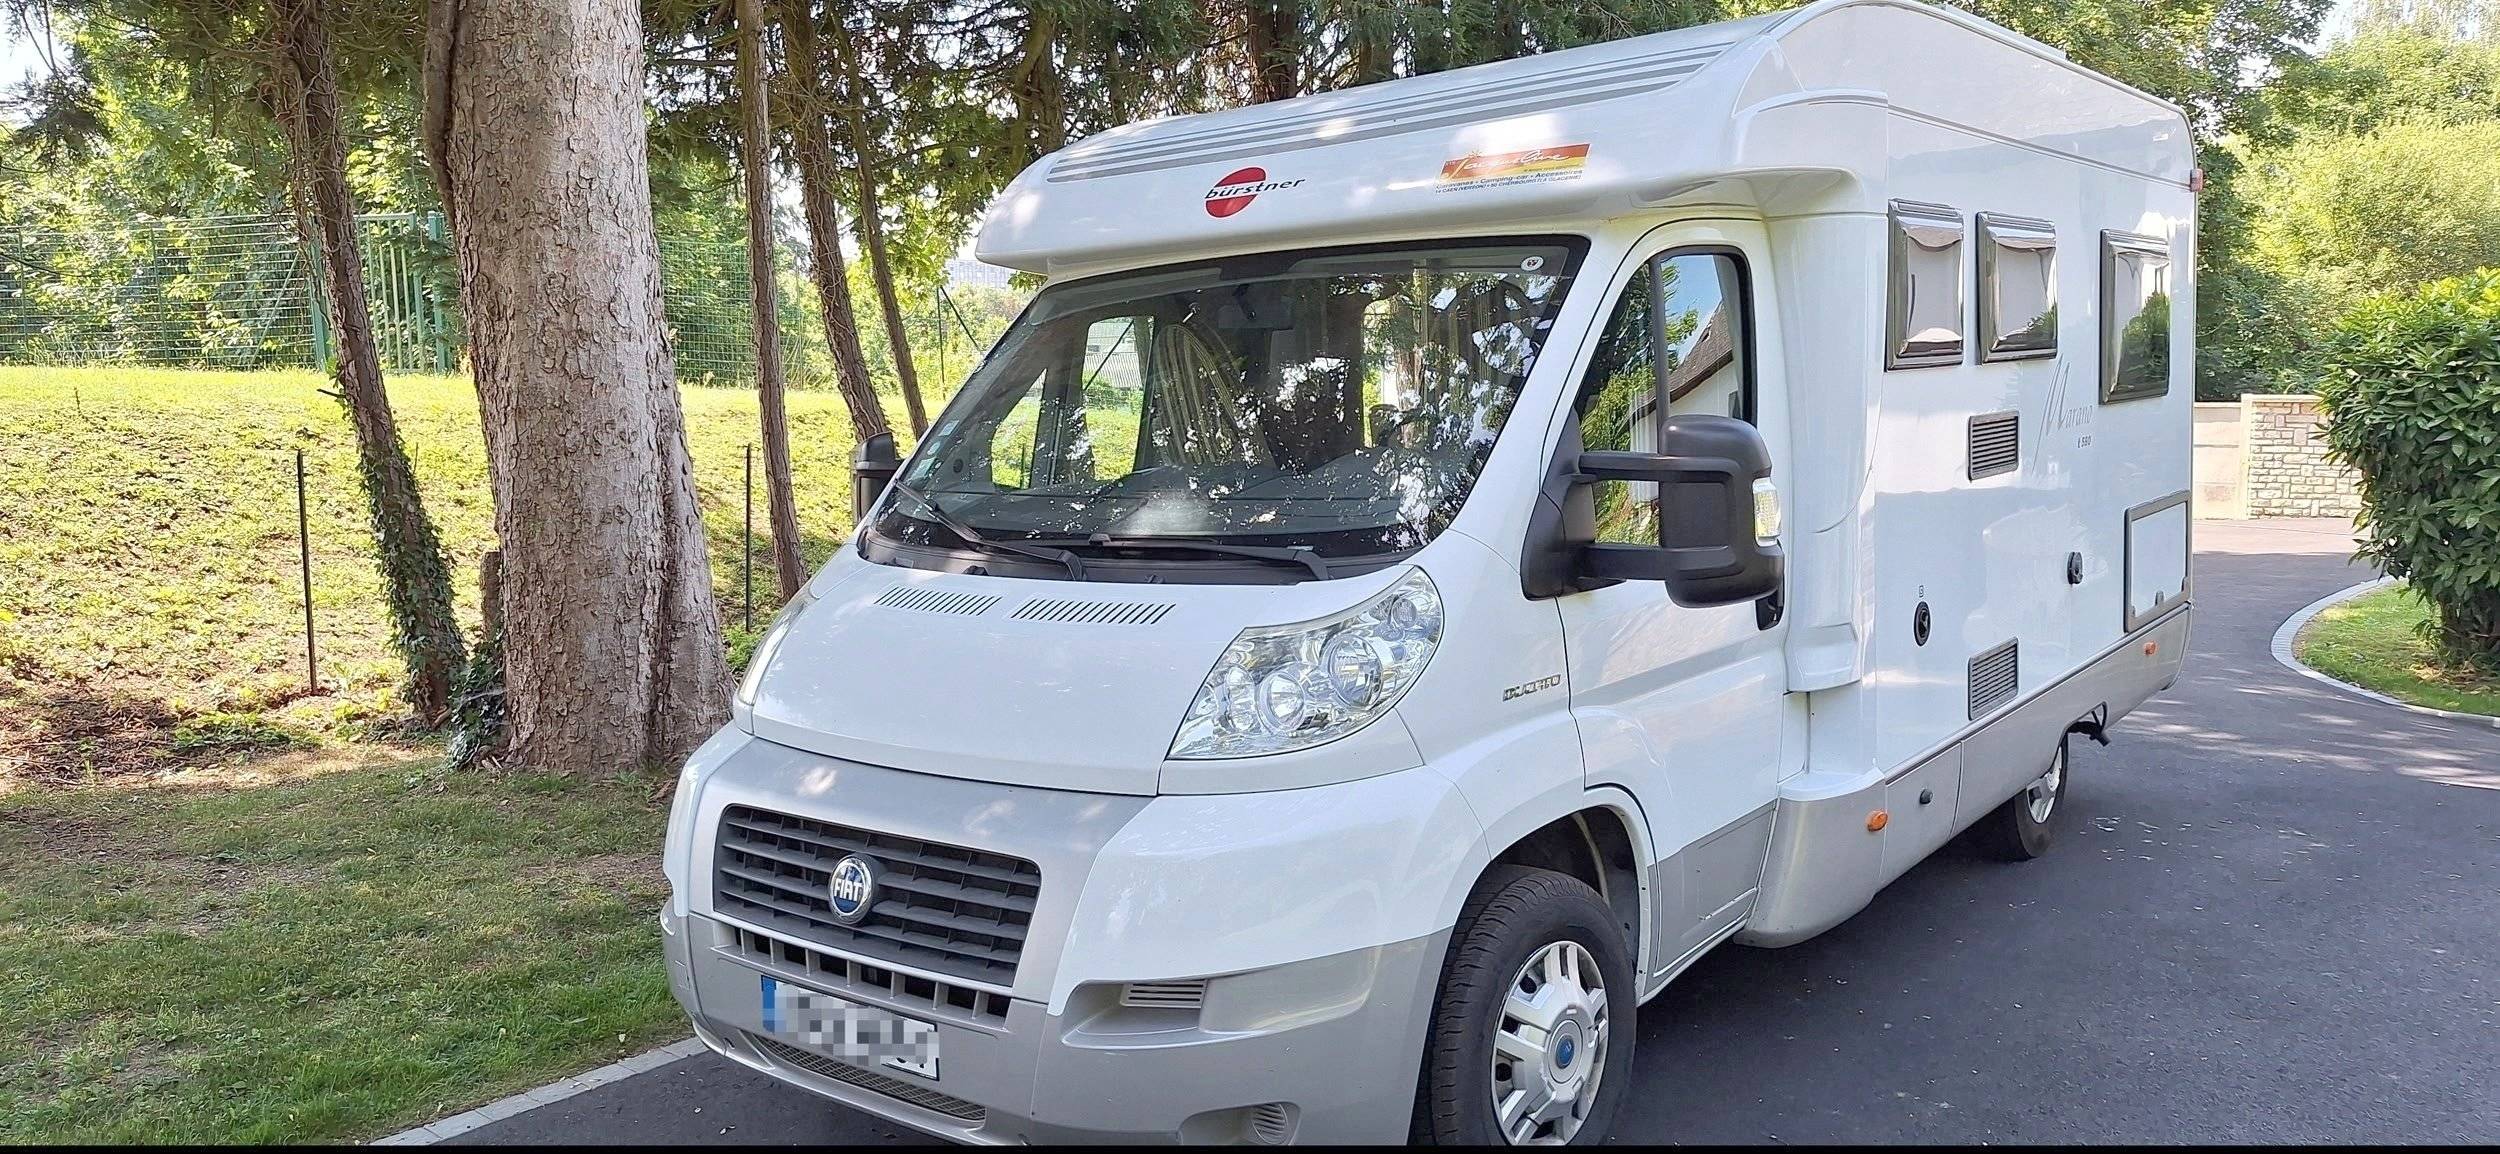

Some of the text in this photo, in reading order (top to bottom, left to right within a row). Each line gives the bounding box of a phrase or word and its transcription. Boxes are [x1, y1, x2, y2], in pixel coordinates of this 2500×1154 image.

[1205, 179, 1306, 200] bürstner
[1437, 180, 1474, 190] Caravanes
[1534, 170, 1583, 179] Accessoires
[833, 878, 863, 902] FIAT
